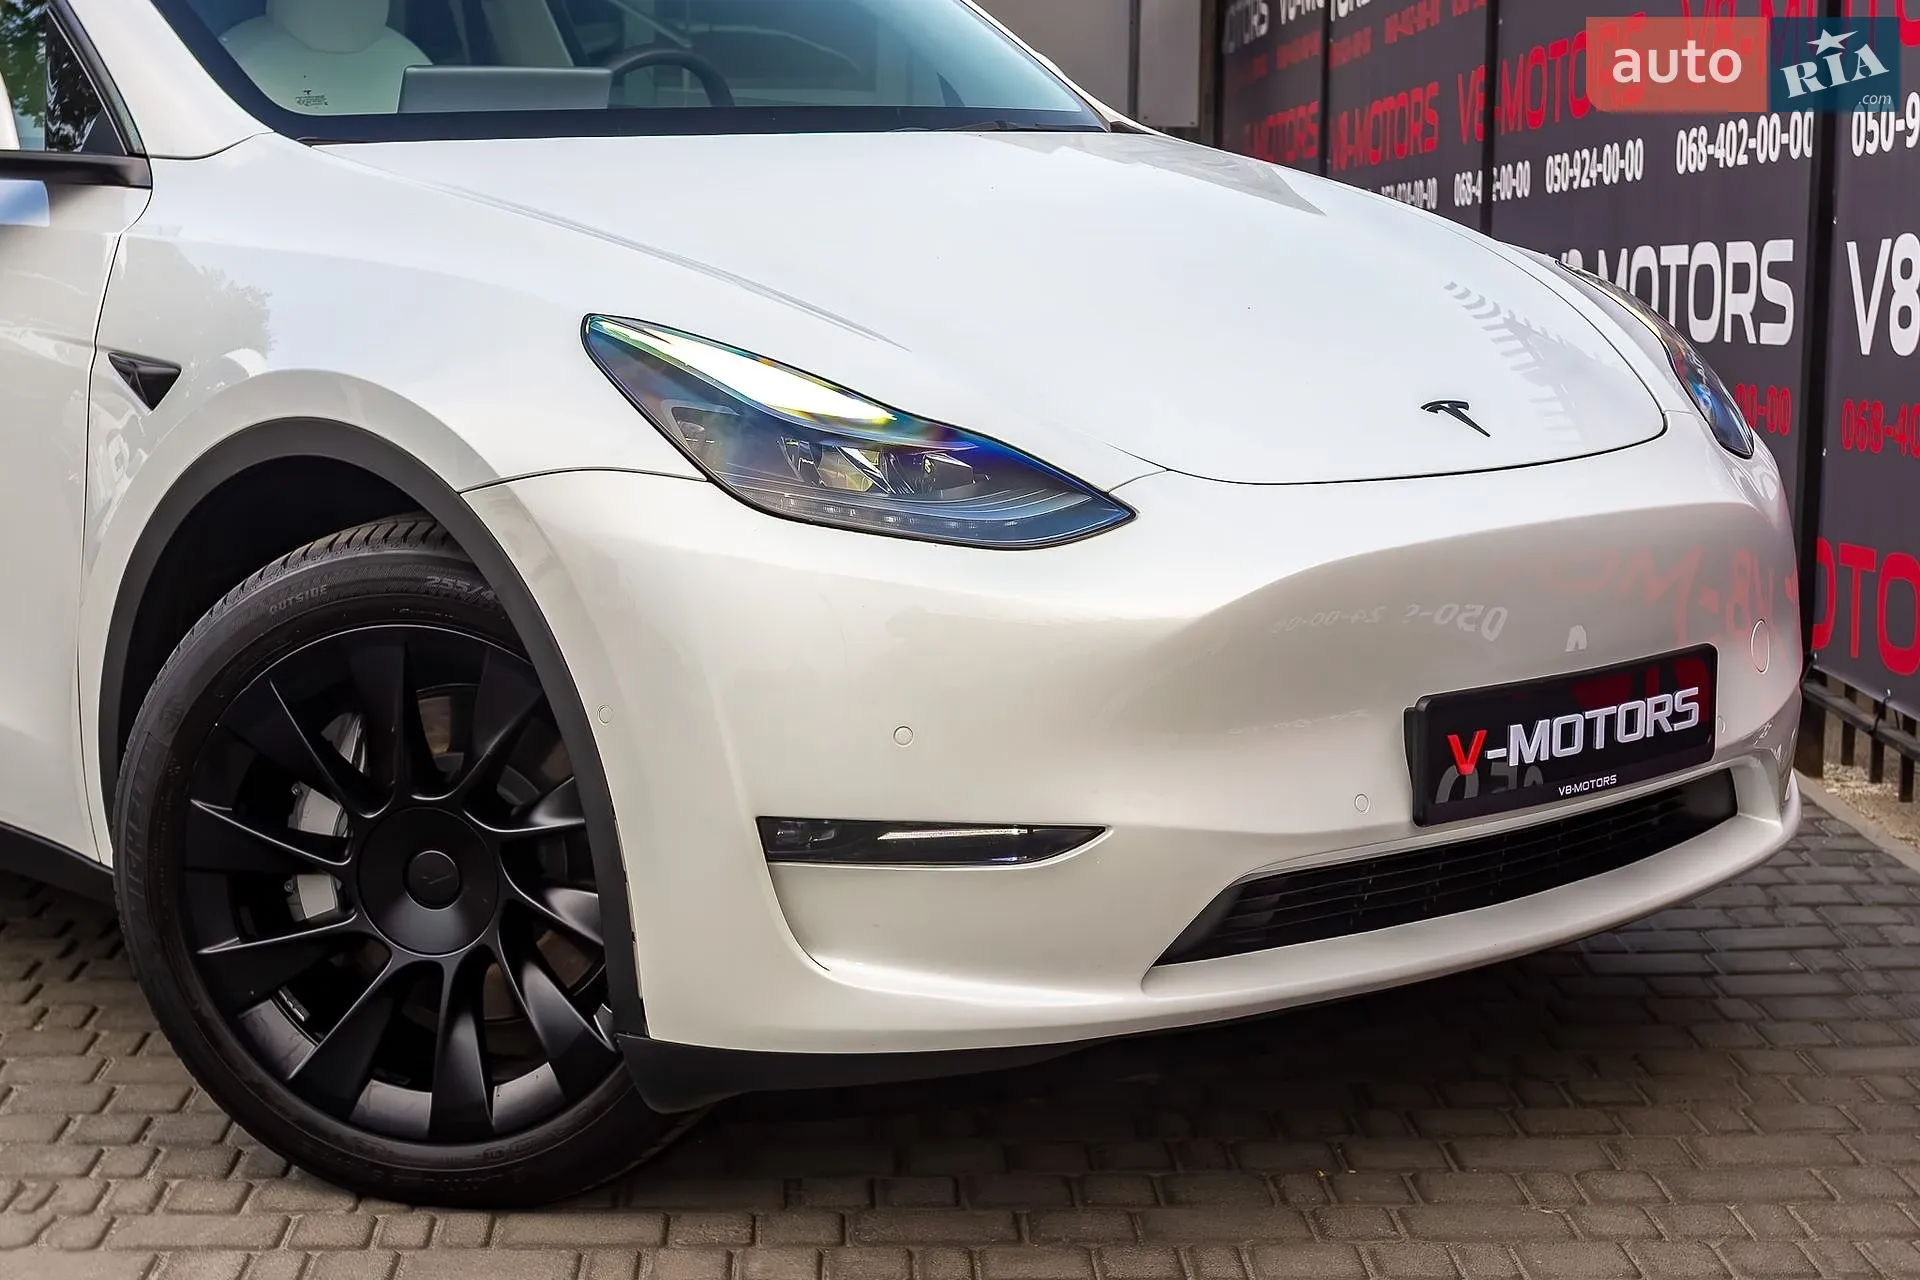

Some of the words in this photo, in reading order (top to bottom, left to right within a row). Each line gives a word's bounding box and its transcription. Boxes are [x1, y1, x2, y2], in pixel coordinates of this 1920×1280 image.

[1545, 137, 1644, 194] 050-924-00-00
[1676, 107, 1815, 175] 068-402-00-00
[1846, 232, 1920, 357] V8
[1447, 686, 1700, 776] V-MOTORS
[1558, 774, 1617, 796] V8-MOTORS
